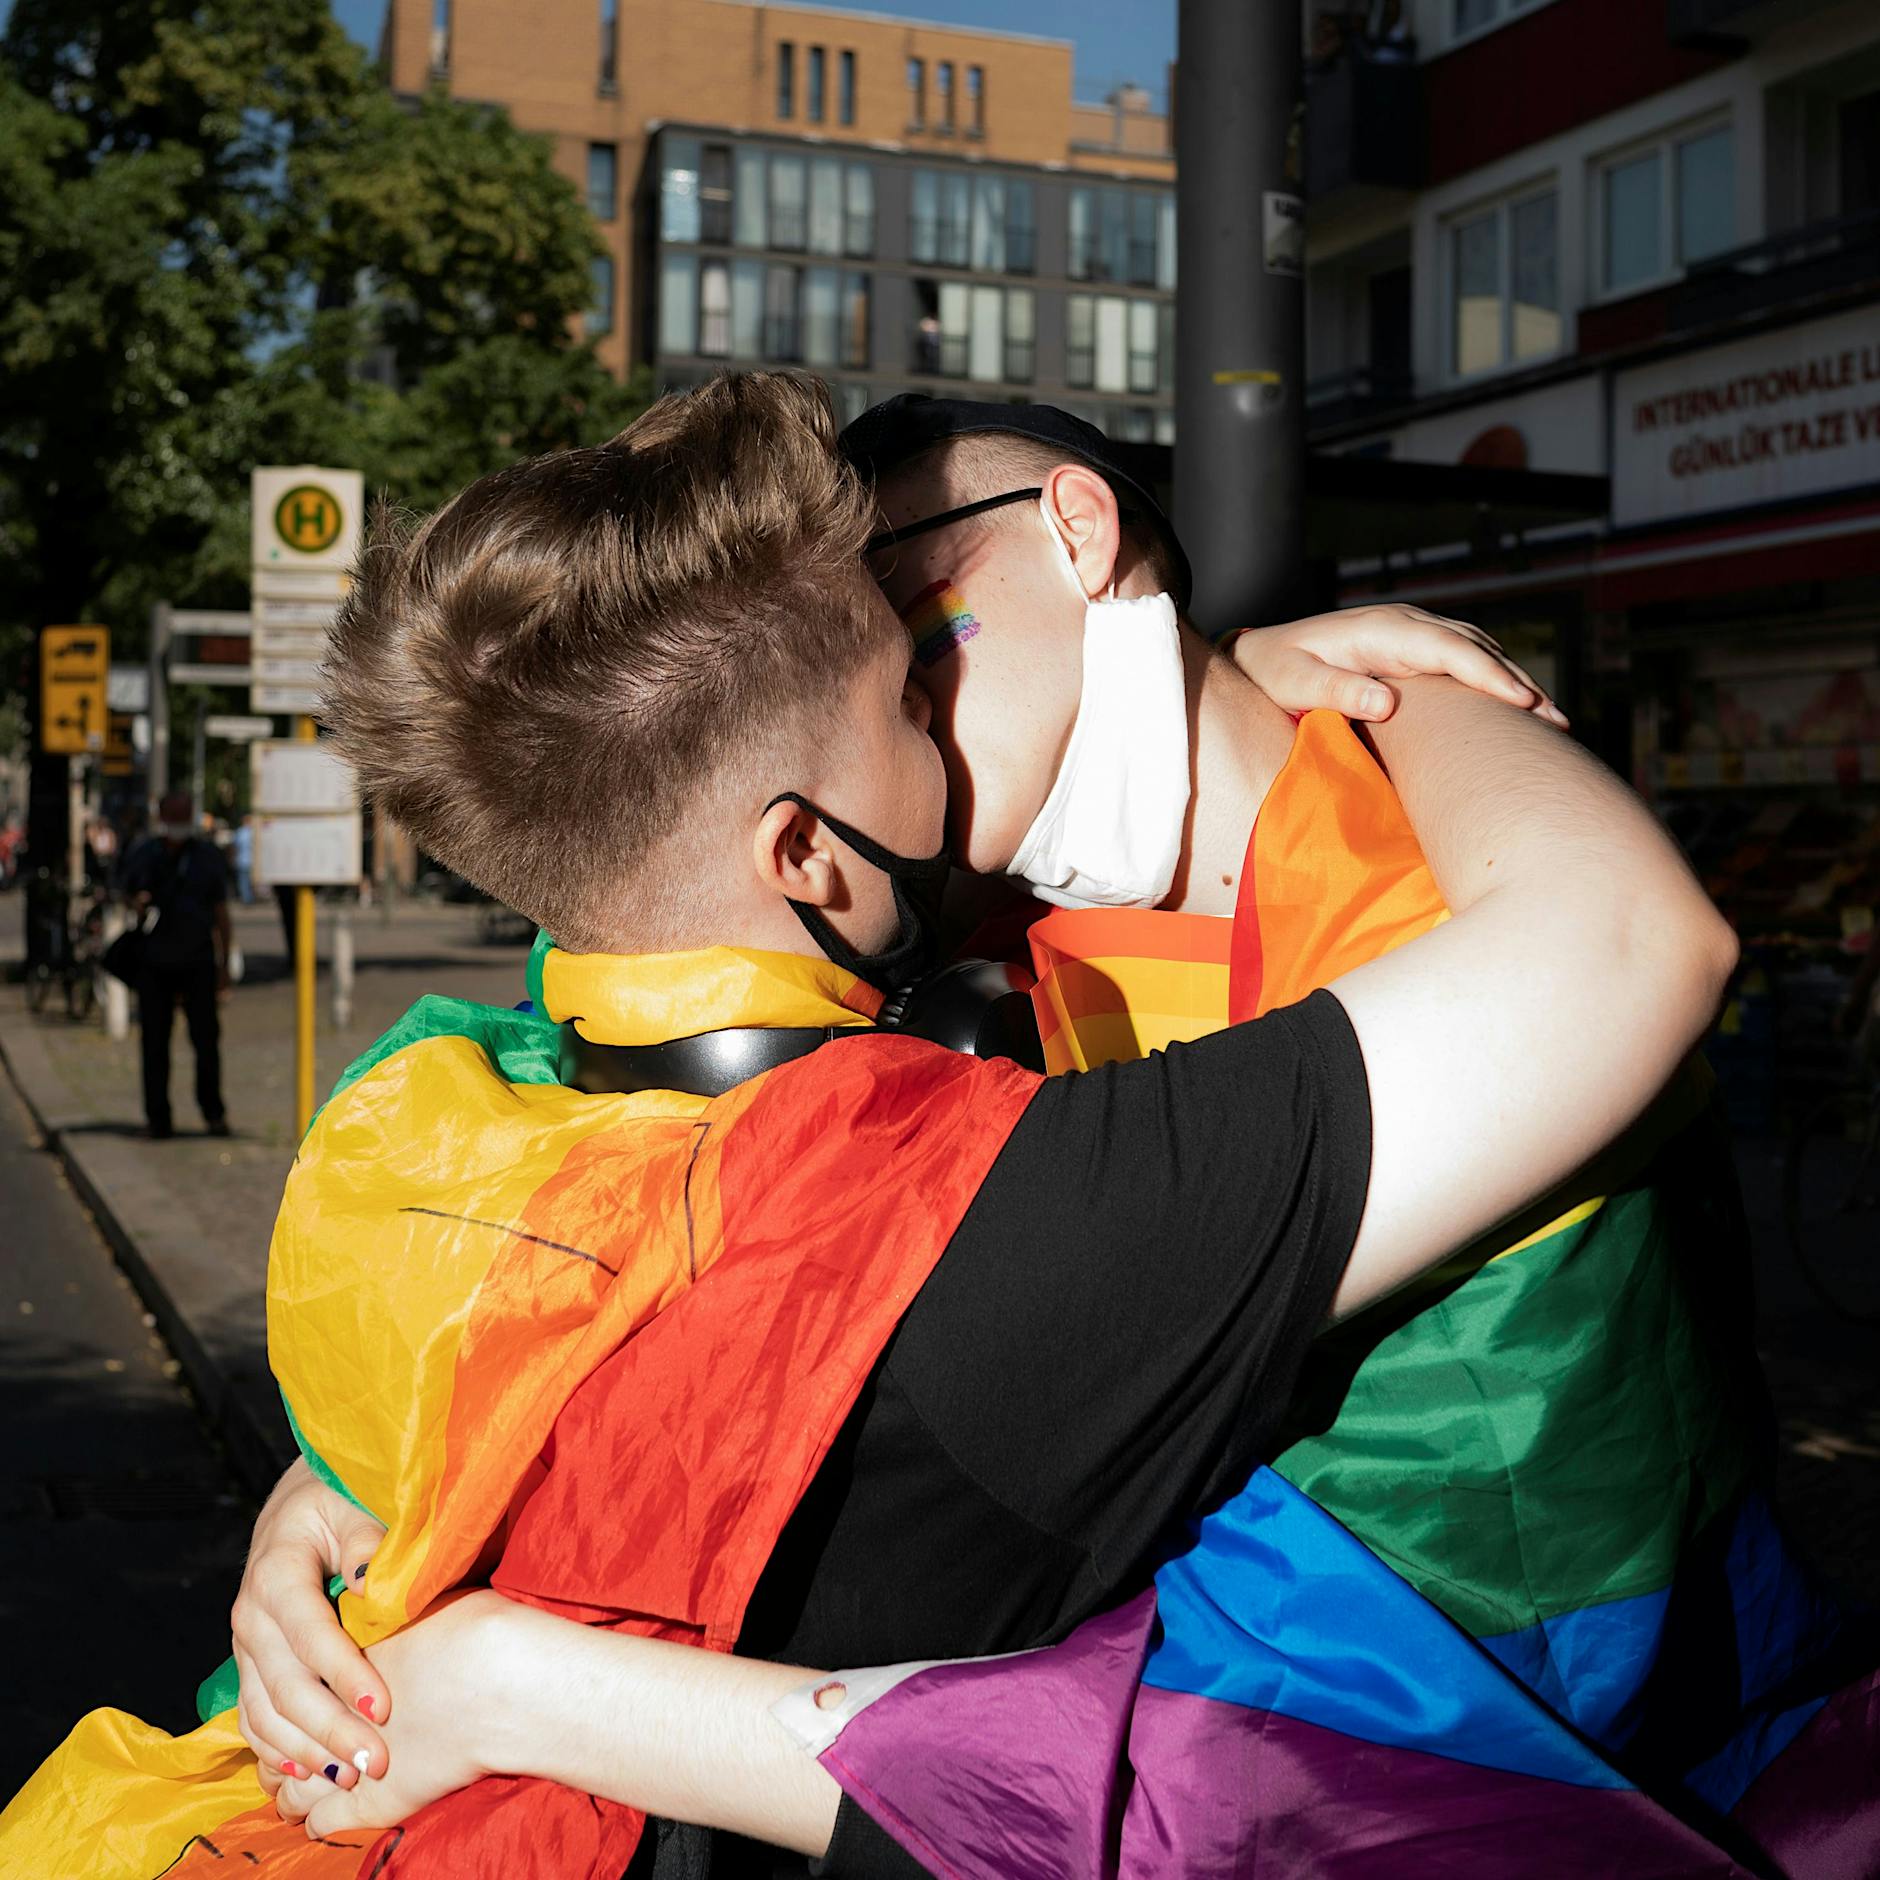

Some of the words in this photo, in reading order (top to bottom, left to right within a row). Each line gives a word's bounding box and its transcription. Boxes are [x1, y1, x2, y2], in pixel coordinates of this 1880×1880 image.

[1633, 350, 1855, 432] INTERNATIONALE
[1861, 343, 1880, 382] L
[1669, 424, 1776, 478] GÜNLÜK
[1780, 411, 1847, 456] TAZE
[294, 503, 325, 536] H
